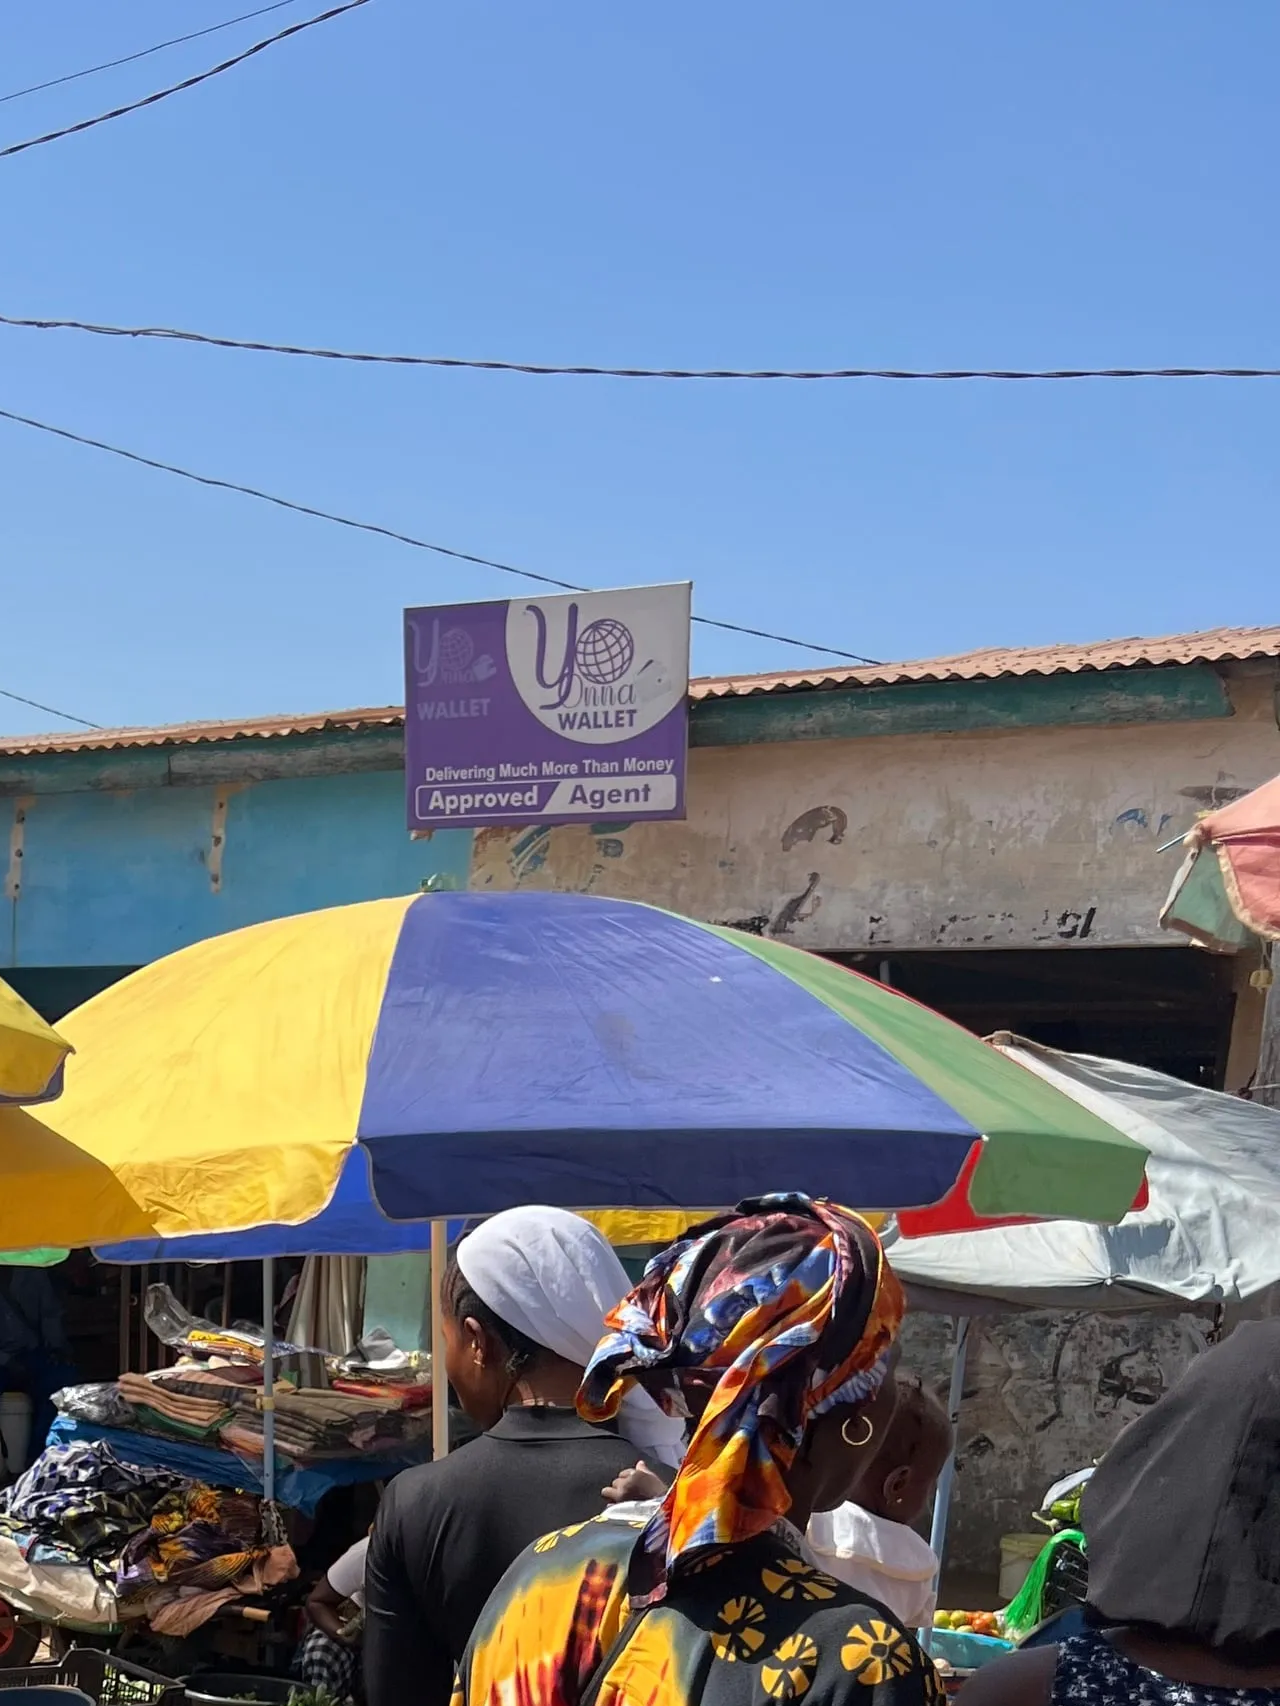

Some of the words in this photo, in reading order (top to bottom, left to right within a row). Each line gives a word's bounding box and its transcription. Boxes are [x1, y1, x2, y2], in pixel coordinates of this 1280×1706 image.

[416, 697, 491, 721] WALLET
[557, 709, 637, 731] WALLET
[425, 765, 495, 782] Delivering
[498, 762, 538, 777] Much
[541, 760, 579, 775] More
[582, 758, 619, 773] Than
[623, 757, 675, 775] Money
[428, 785, 538, 815] Approved
[569, 783, 651, 810] Agent
